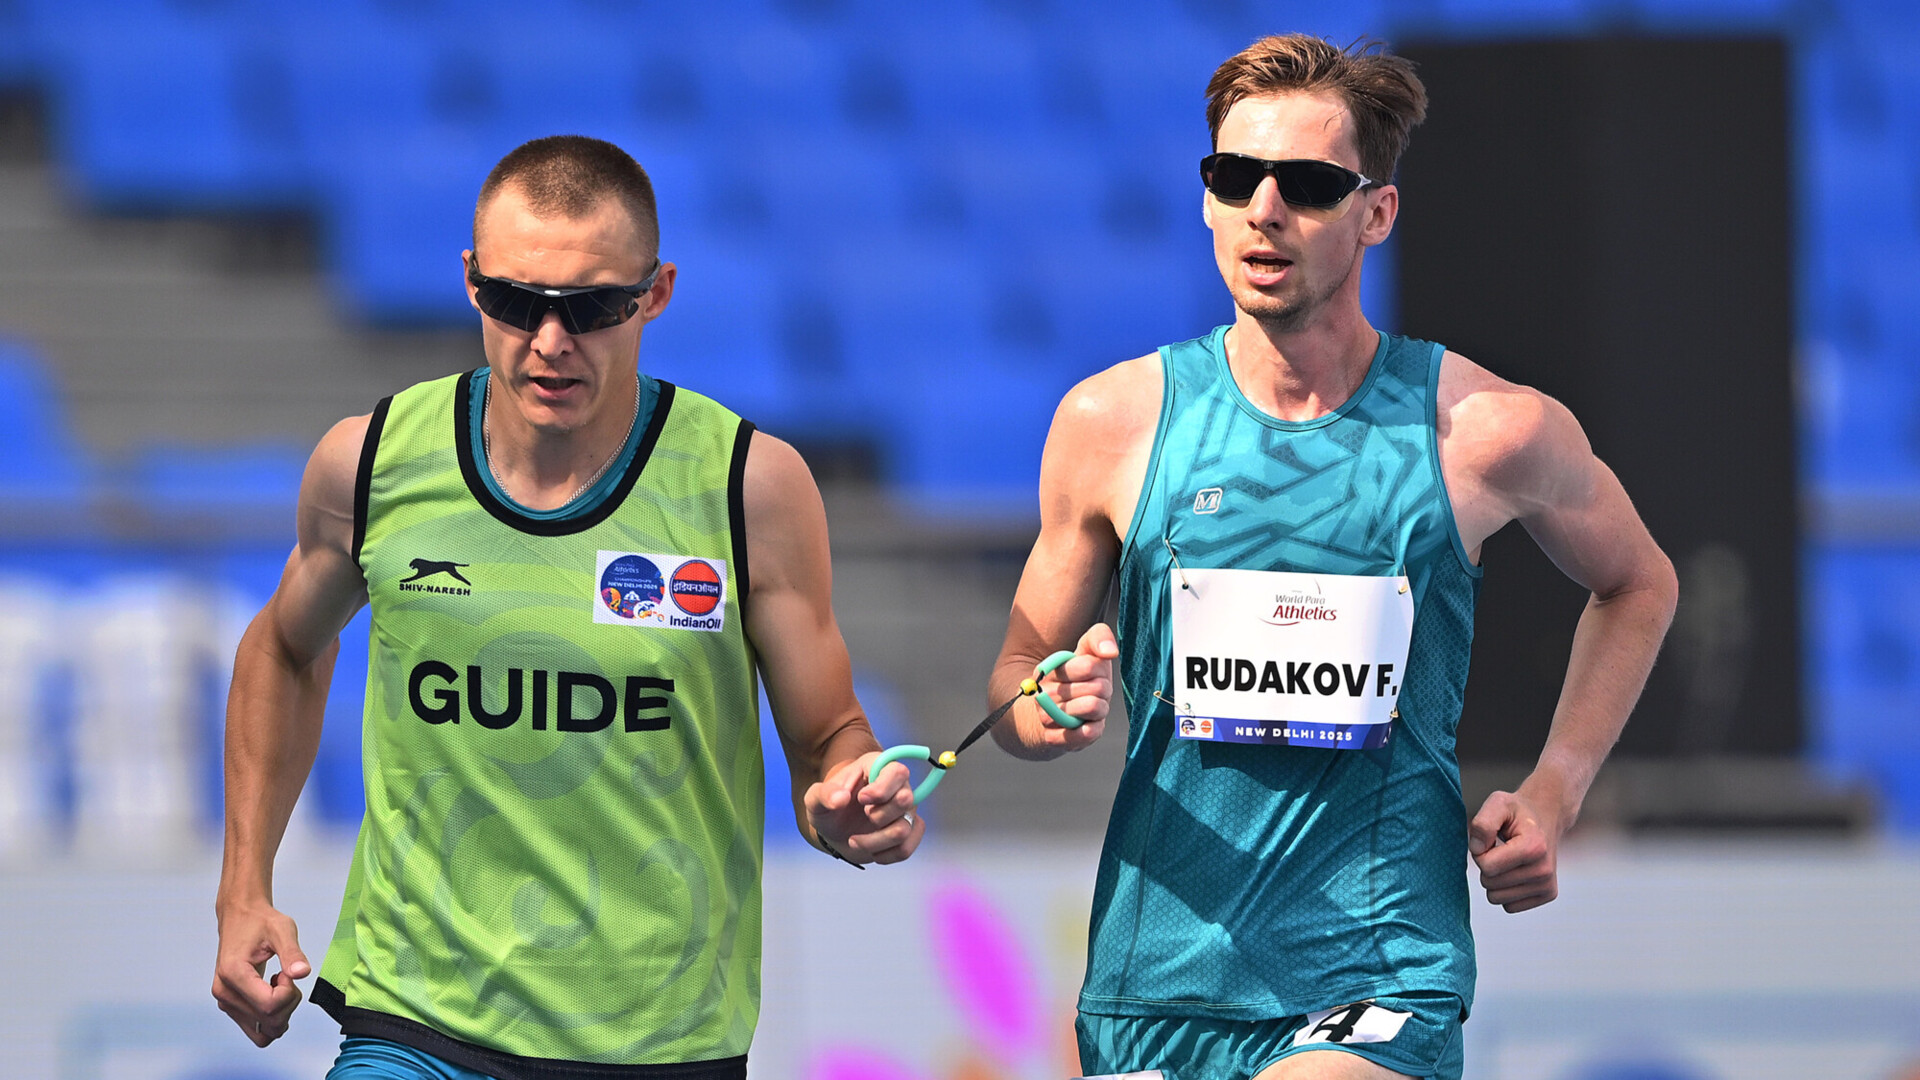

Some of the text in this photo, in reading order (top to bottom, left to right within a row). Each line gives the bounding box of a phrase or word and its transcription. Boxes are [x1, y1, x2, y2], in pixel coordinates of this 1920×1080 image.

[399, 583, 471, 596] SHIV-NARESH
[1275, 594, 1326, 605] World Para
[1272, 605, 1337, 621] Athletics
[669, 615, 722, 630] IndianOil
[1186, 656, 1398, 697] RUDAKOV F.
[408, 660, 675, 733] GUIDE
[1235, 726, 1353, 741] NEW DELHI 2025
[1308, 1001, 1372, 1042] 4
